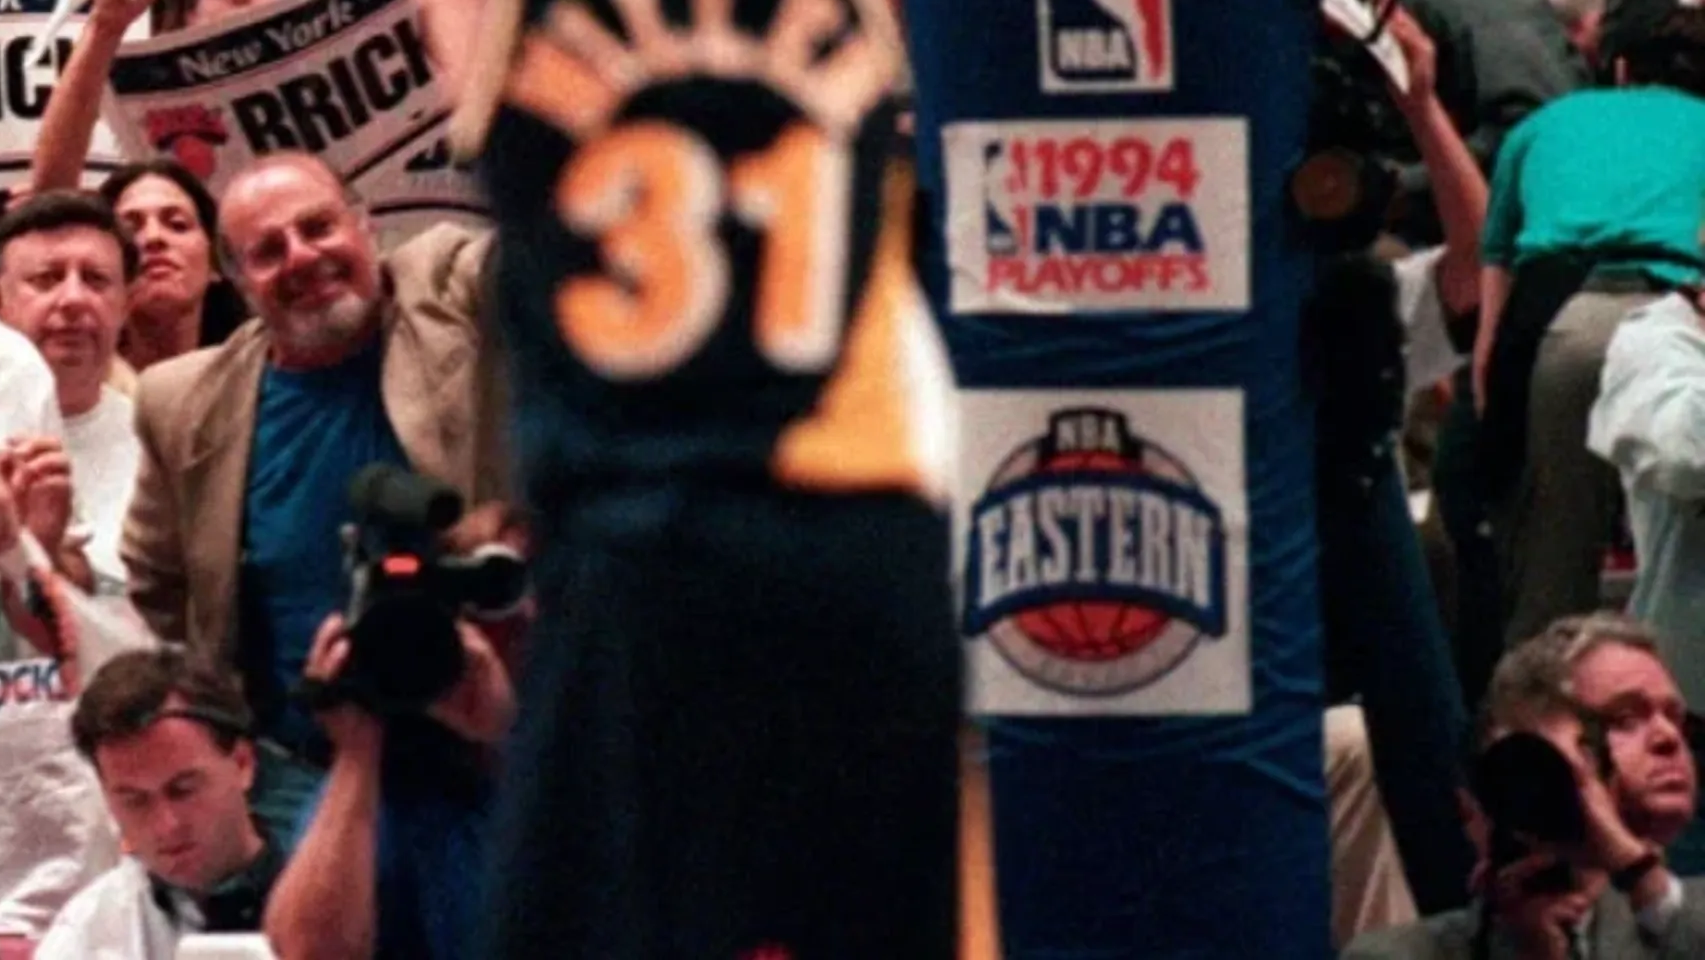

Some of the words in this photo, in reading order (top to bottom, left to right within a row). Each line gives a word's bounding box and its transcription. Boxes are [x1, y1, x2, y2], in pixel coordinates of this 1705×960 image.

[175, 38, 263, 83] New
[1034, 136, 1202, 198] 1994
[554, 119, 849, 382] 31
[1035, 202, 1204, 254] NBA
[986, 255, 1211, 293] PLAYOFFS
[979, 487, 1211, 607] EASTERN
